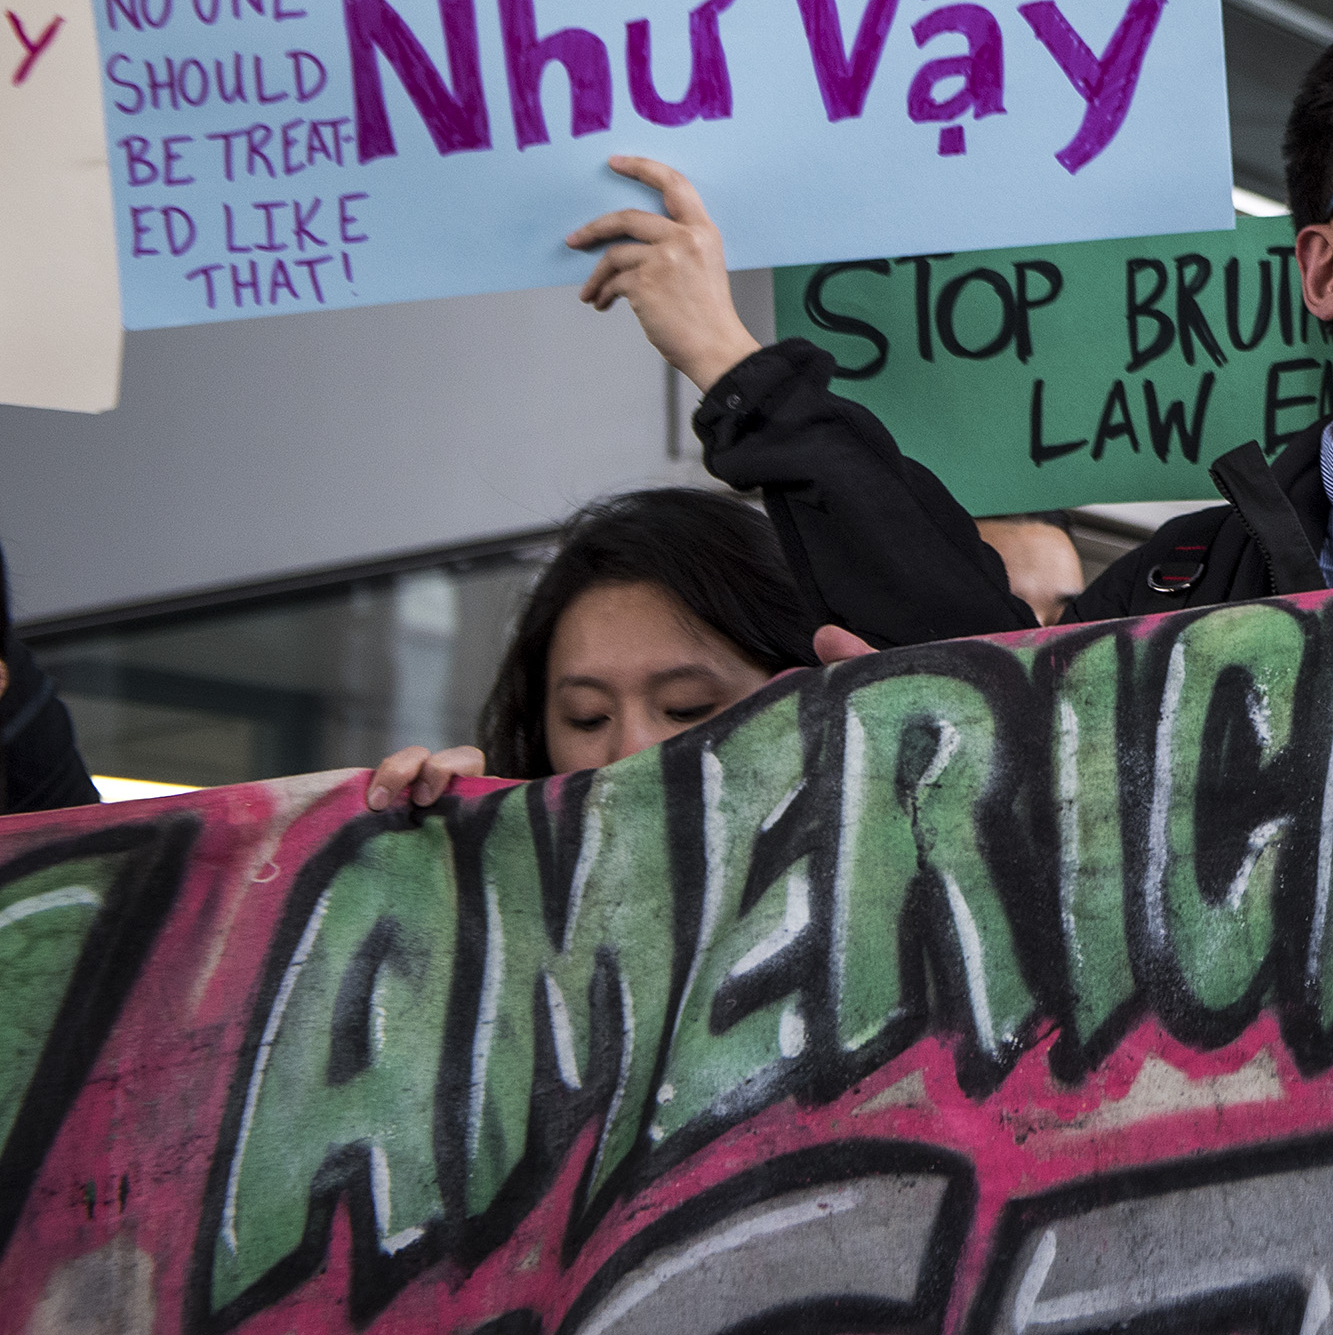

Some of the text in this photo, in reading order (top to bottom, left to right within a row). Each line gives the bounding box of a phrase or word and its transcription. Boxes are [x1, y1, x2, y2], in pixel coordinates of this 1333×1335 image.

[107, 50, 327, 114] SHOULD
[119, 135, 195, 186] BE
[129, 193, 369, 257] ED LIKE
[185, 251, 358, 308] THAT!
[804, 253, 1064, 383] STOP
[1030, 370, 1216, 465] LAW
